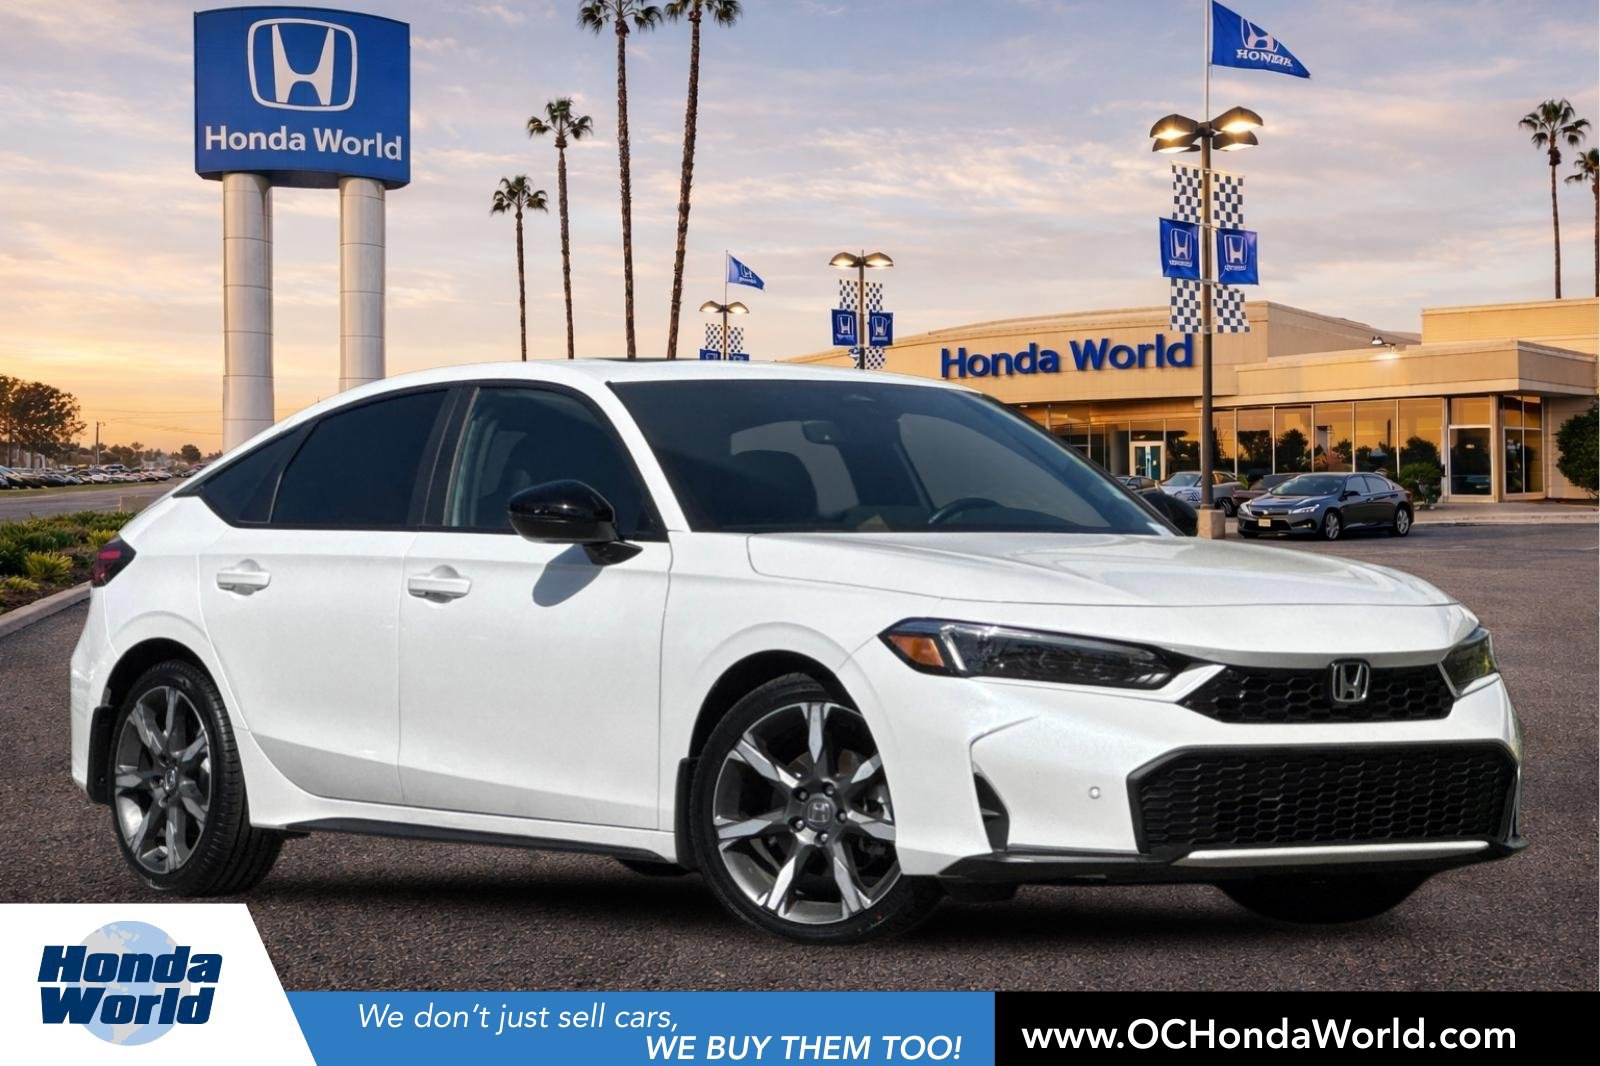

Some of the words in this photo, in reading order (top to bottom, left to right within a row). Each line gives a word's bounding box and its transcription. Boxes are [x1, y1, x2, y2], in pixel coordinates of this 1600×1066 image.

[205, 125, 306, 151] Honda
[313, 127, 402, 160] World
[941, 342, 1060, 378] Honda
[1069, 333, 1194, 371] World
